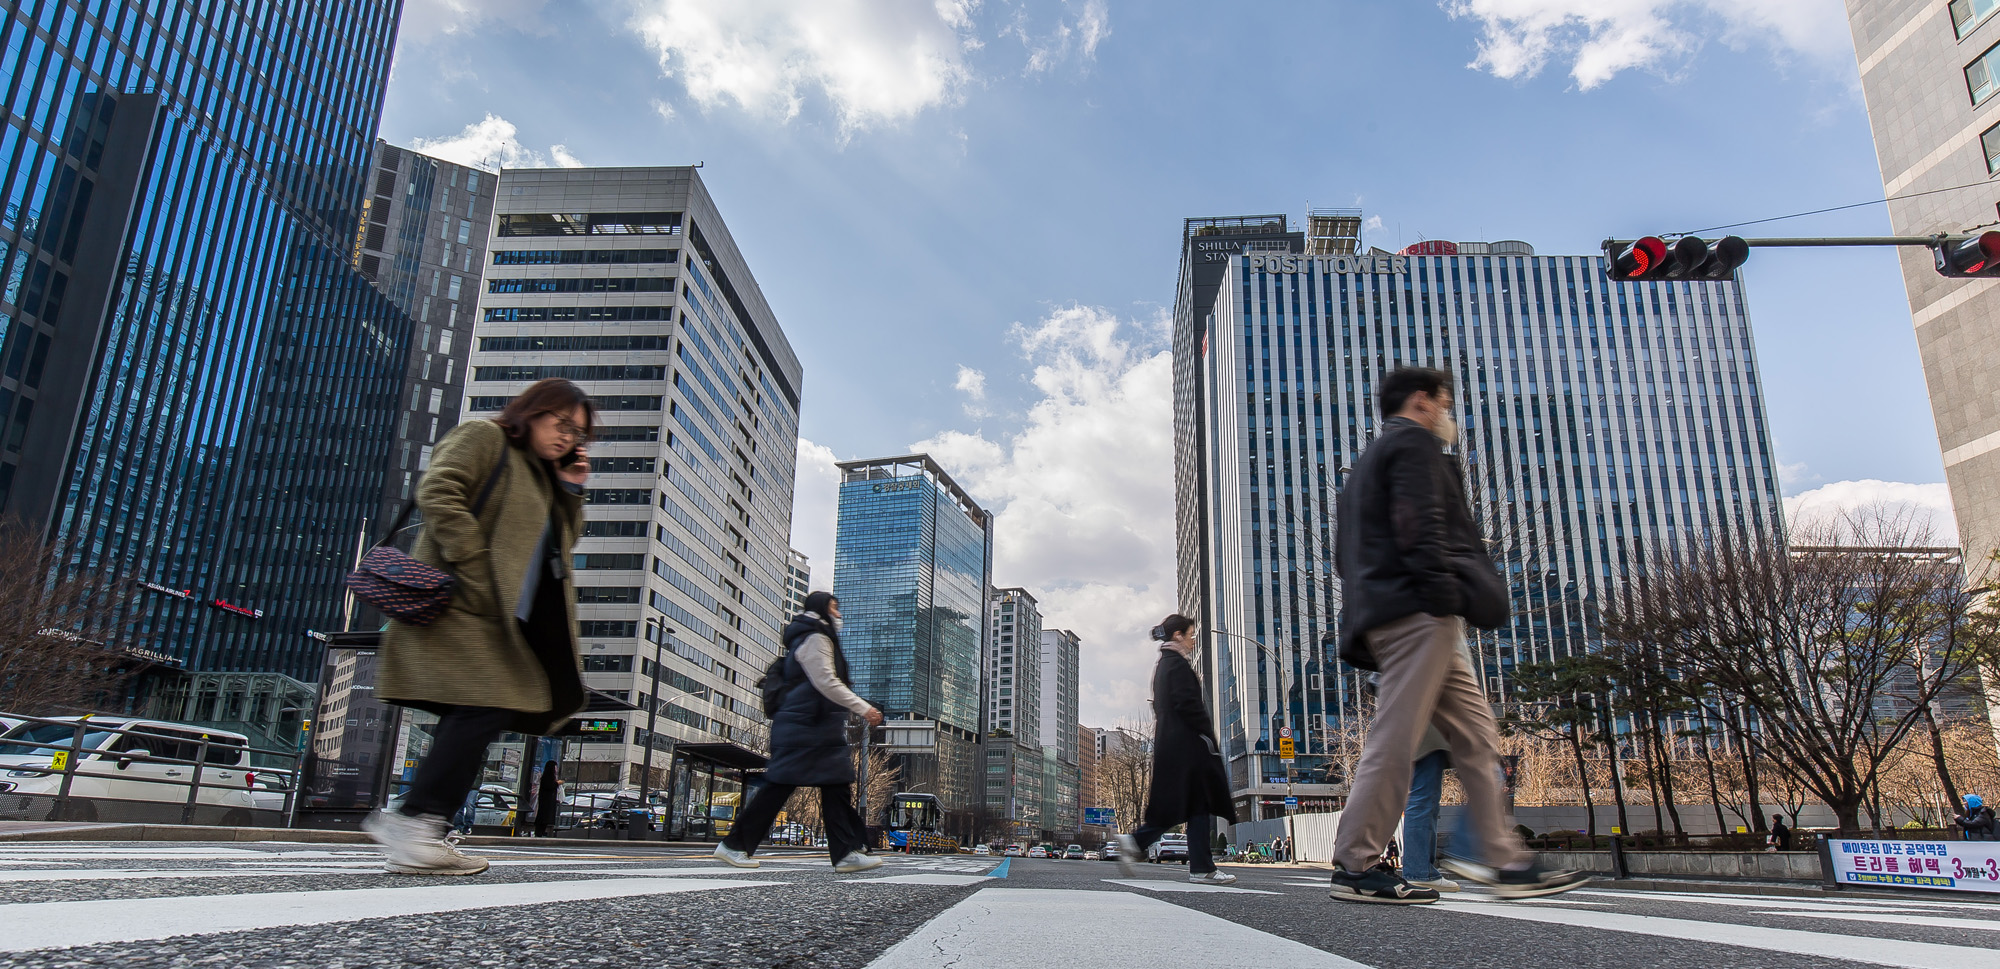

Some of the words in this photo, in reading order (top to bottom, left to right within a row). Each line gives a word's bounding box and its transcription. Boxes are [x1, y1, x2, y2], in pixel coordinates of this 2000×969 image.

[1198, 242, 1240, 250] SHILLA
[1205, 252, 1232, 262] STAY
[1250, 256, 1312, 274] POST
[1317, 256, 1408, 274] TOWER
[126, 645, 173, 661] LAGRILLIA
[1842, 842, 1880, 854] 에이원짐
[1882, 843, 1904, 855] 마포
[1905, 843, 1947, 856] 공덕역점
[1853, 856, 1899, 872] 트리플
[1908, 857, 1941, 874] 혜택
[1895, 875, 1902, 883] 수
